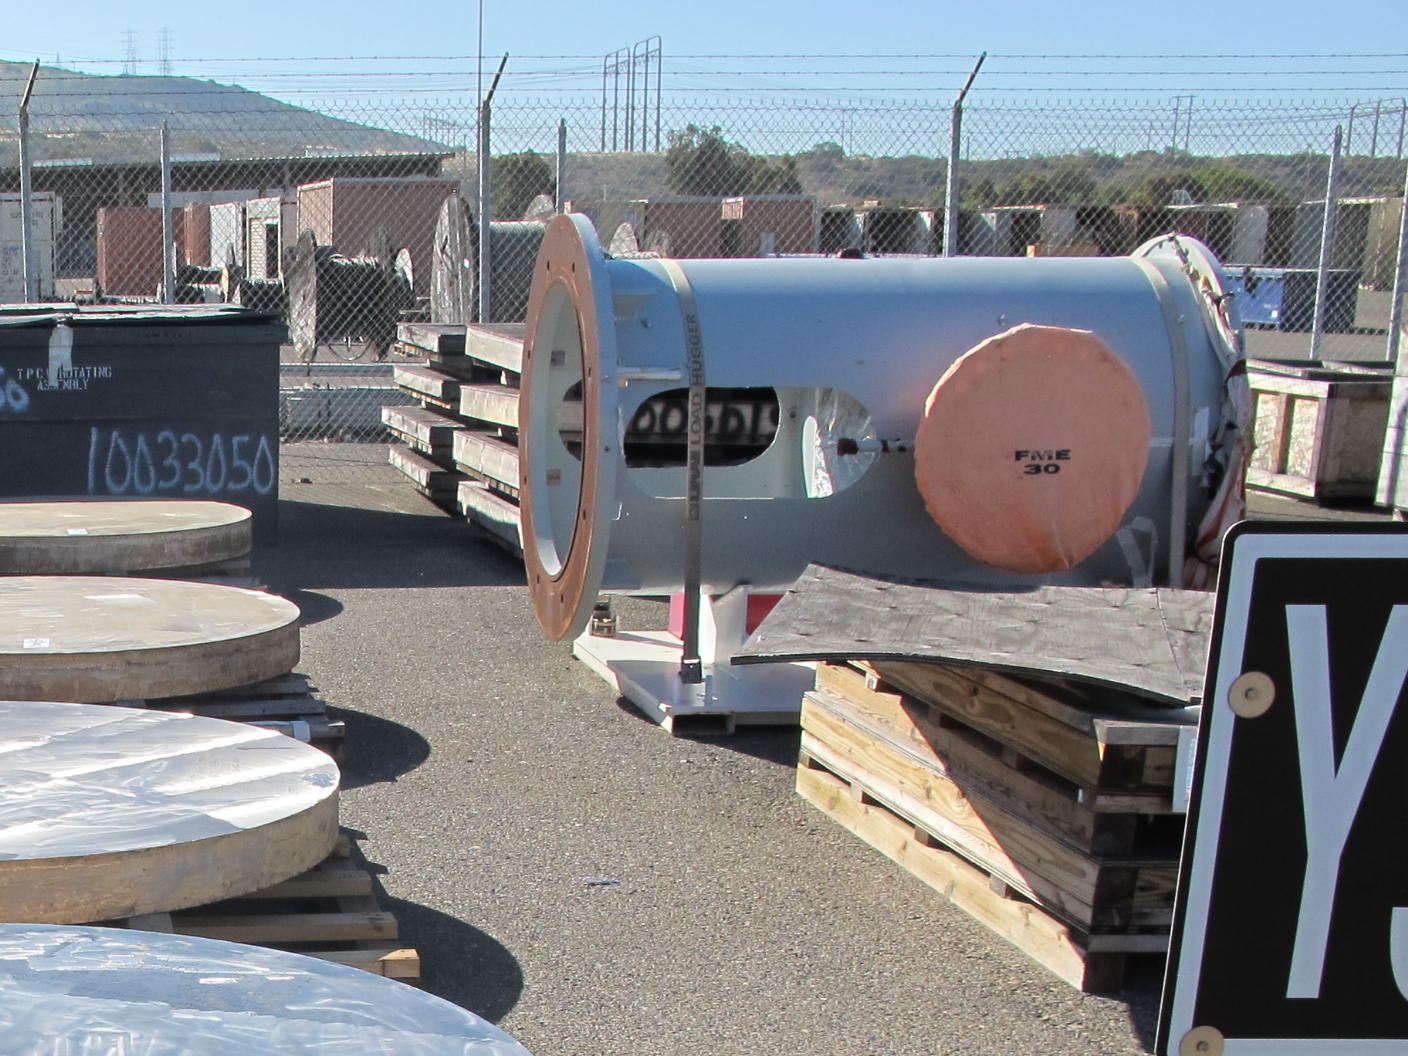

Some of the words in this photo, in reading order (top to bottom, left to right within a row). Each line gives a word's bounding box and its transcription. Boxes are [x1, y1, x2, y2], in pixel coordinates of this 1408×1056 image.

[690, 392, 702, 446] LOAD
[87, 426, 276, 494] 10033050
[1014, 448, 1072, 461] FME
[1023, 463, 1061, 475] 30
